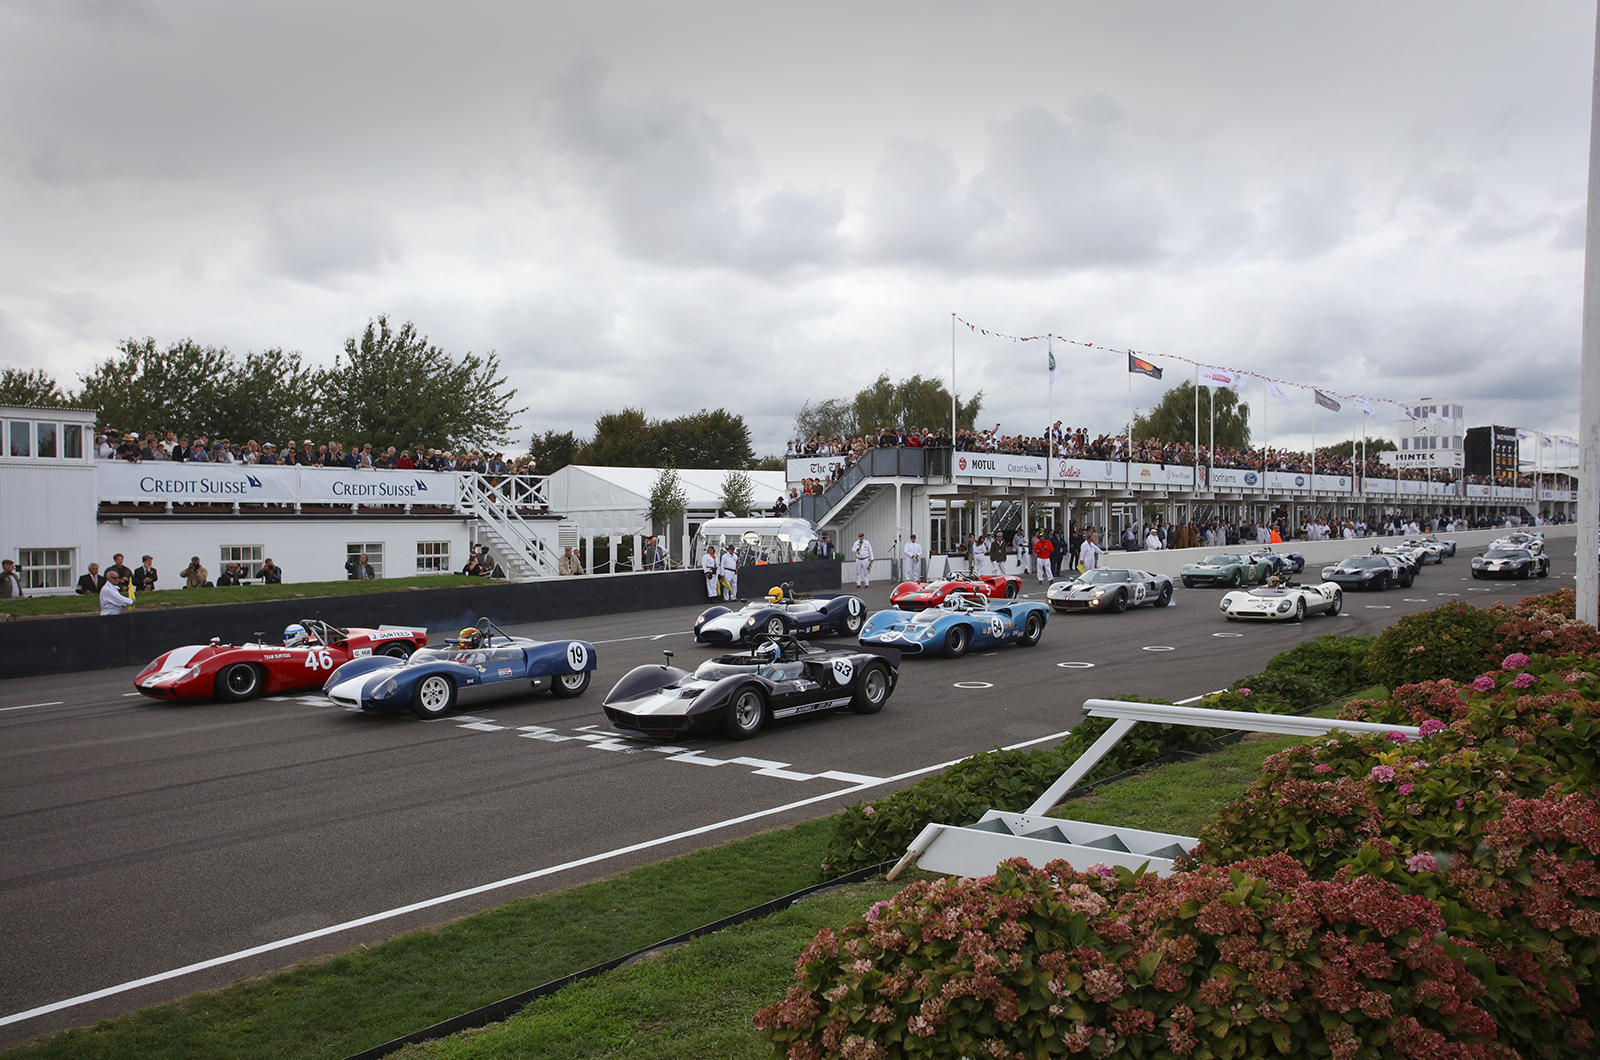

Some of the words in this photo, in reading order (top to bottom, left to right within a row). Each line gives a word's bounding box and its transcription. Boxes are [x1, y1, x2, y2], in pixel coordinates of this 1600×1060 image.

[809, 462, 826, 475] The
[971, 459, 996, 470] MOTUL
[140, 476, 198, 492] CREDIT
[200, 478, 248, 494] SUISSE
[332, 481, 377, 495] CREDIT
[379, 482, 416, 496] SUISSE
[985, 584, 992, 596] 5
[851, 599, 857, 614] 1
[993, 619, 1003, 634] 54
[304, 650, 334, 671] 46
[570, 645, 583, 664] 19
[834, 660, 852, 677] 63
